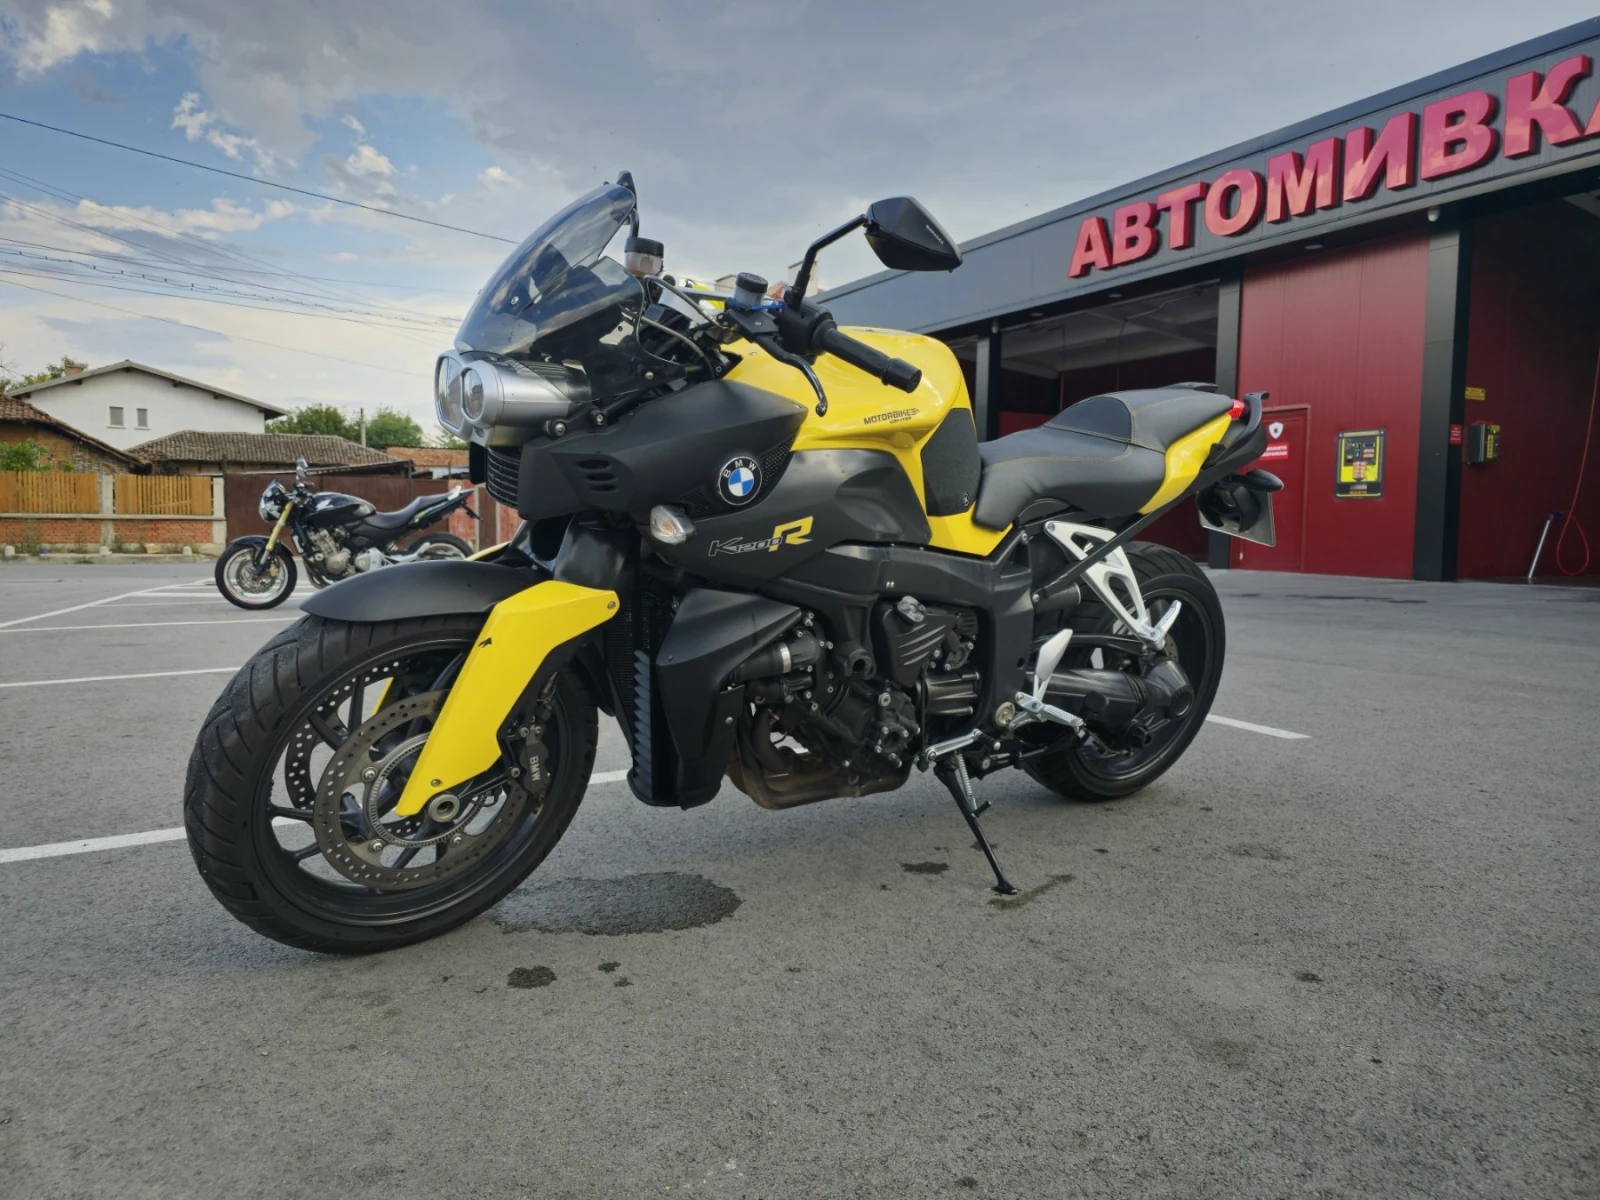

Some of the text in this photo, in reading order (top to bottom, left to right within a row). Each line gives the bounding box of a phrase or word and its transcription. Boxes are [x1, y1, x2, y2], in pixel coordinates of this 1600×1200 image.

[1067, 54, 1600, 278] АВТОМИВК
[722, 459, 757, 479] BMW
[529, 755, 541, 781] BMW
